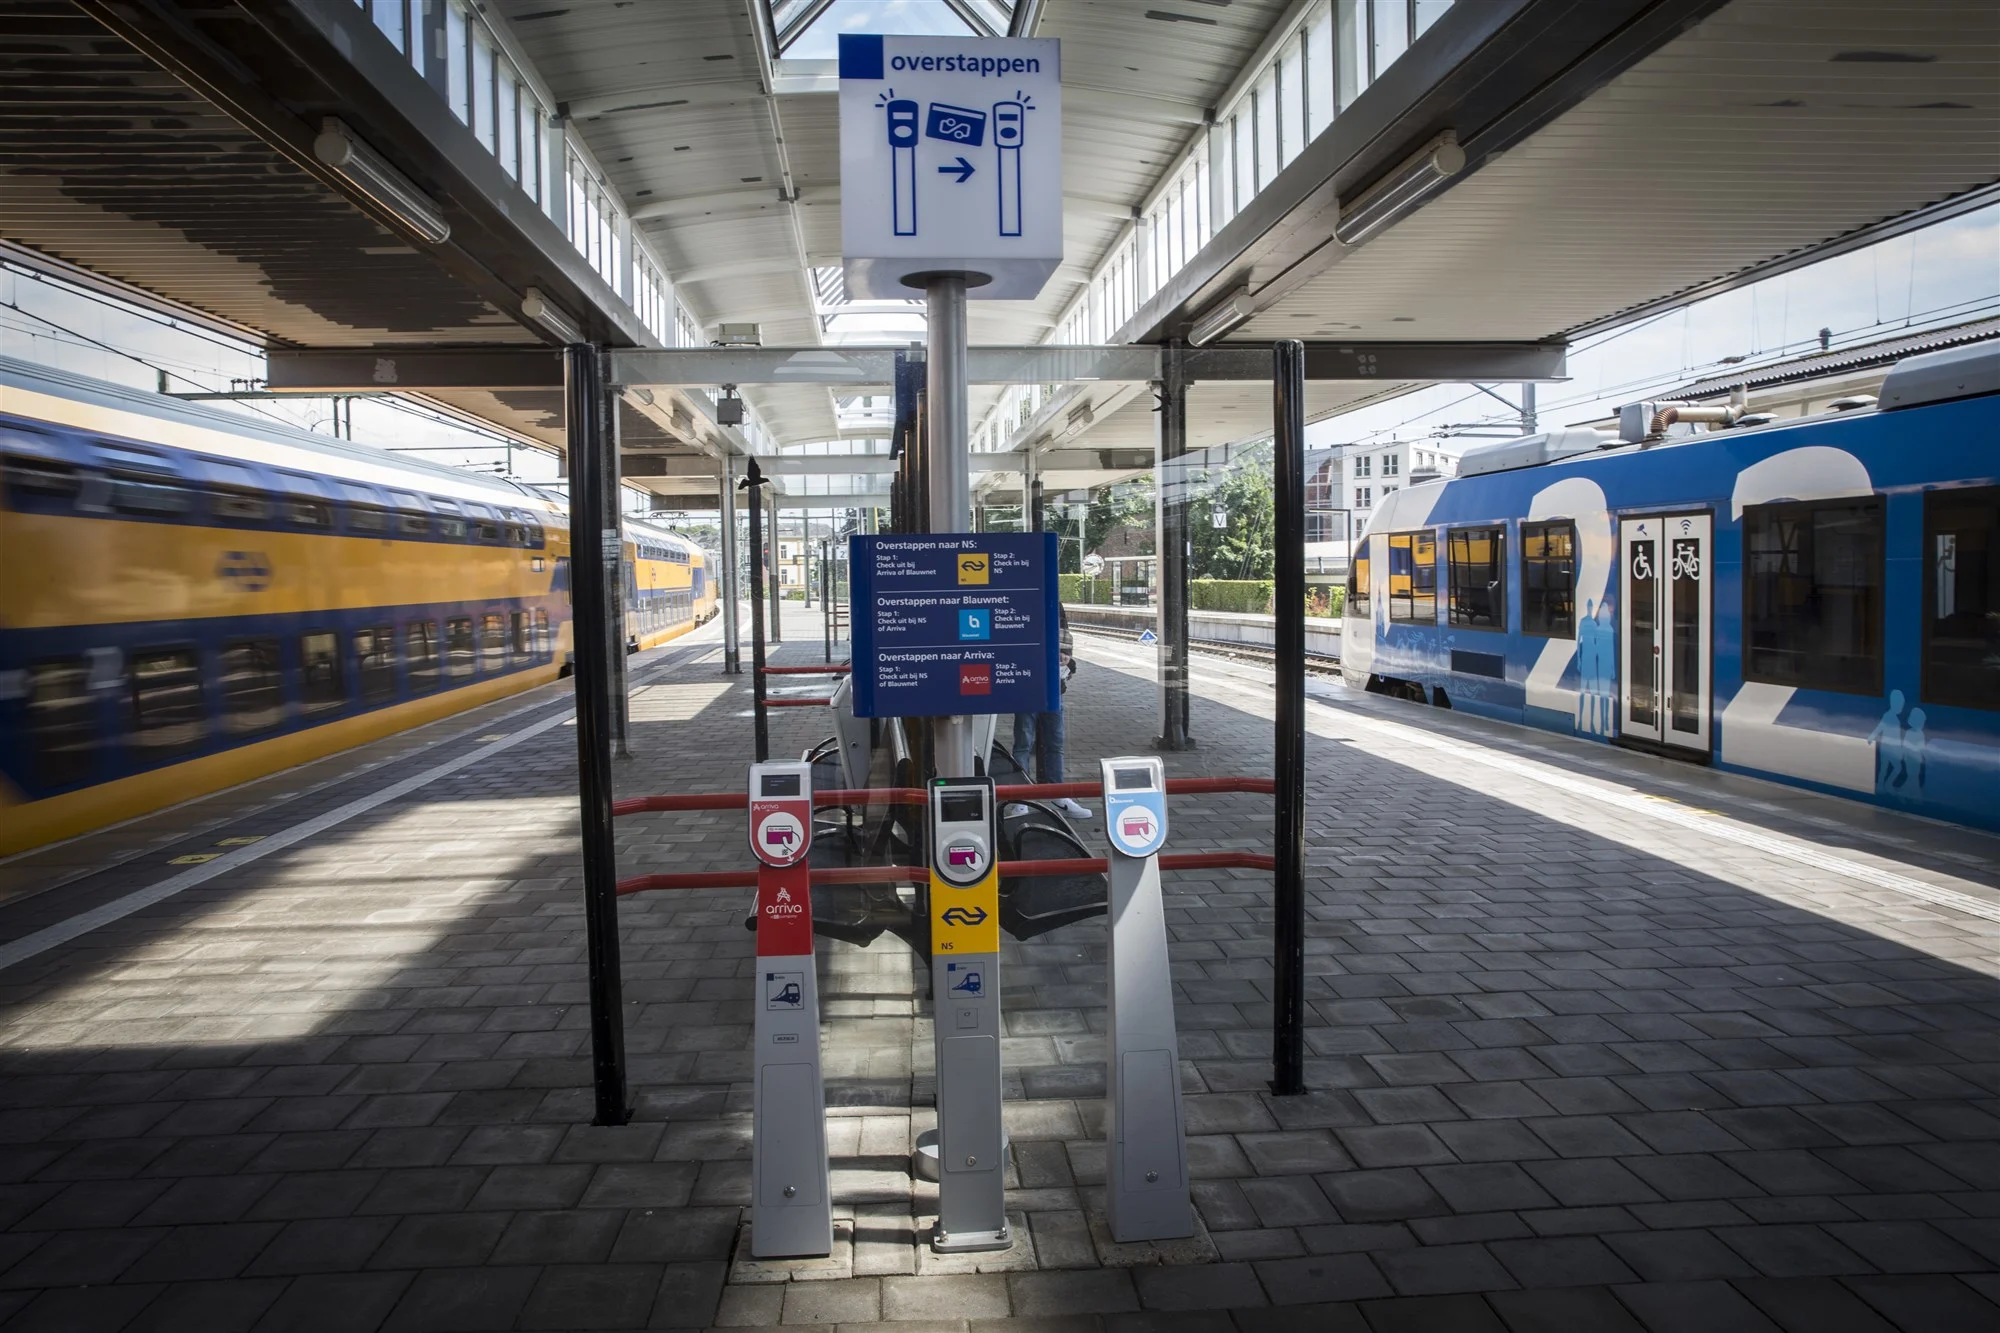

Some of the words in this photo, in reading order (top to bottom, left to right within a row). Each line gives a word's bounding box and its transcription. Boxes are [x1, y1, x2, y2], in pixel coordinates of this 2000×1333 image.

[891, 54, 1040, 77] overstappen
[1215, 514, 1225, 526] V
[876, 541, 936, 551] Overstappen
[961, 540, 977, 548] NS:
[840, 551, 846, 559] 2
[877, 597, 938, 607] Overstappen
[962, 596, 1009, 604] Blauwnet:
[878, 653, 938, 662] Overstappen
[964, 651, 994, 659] Arriva:
[766, 903, 802, 914] arriva
